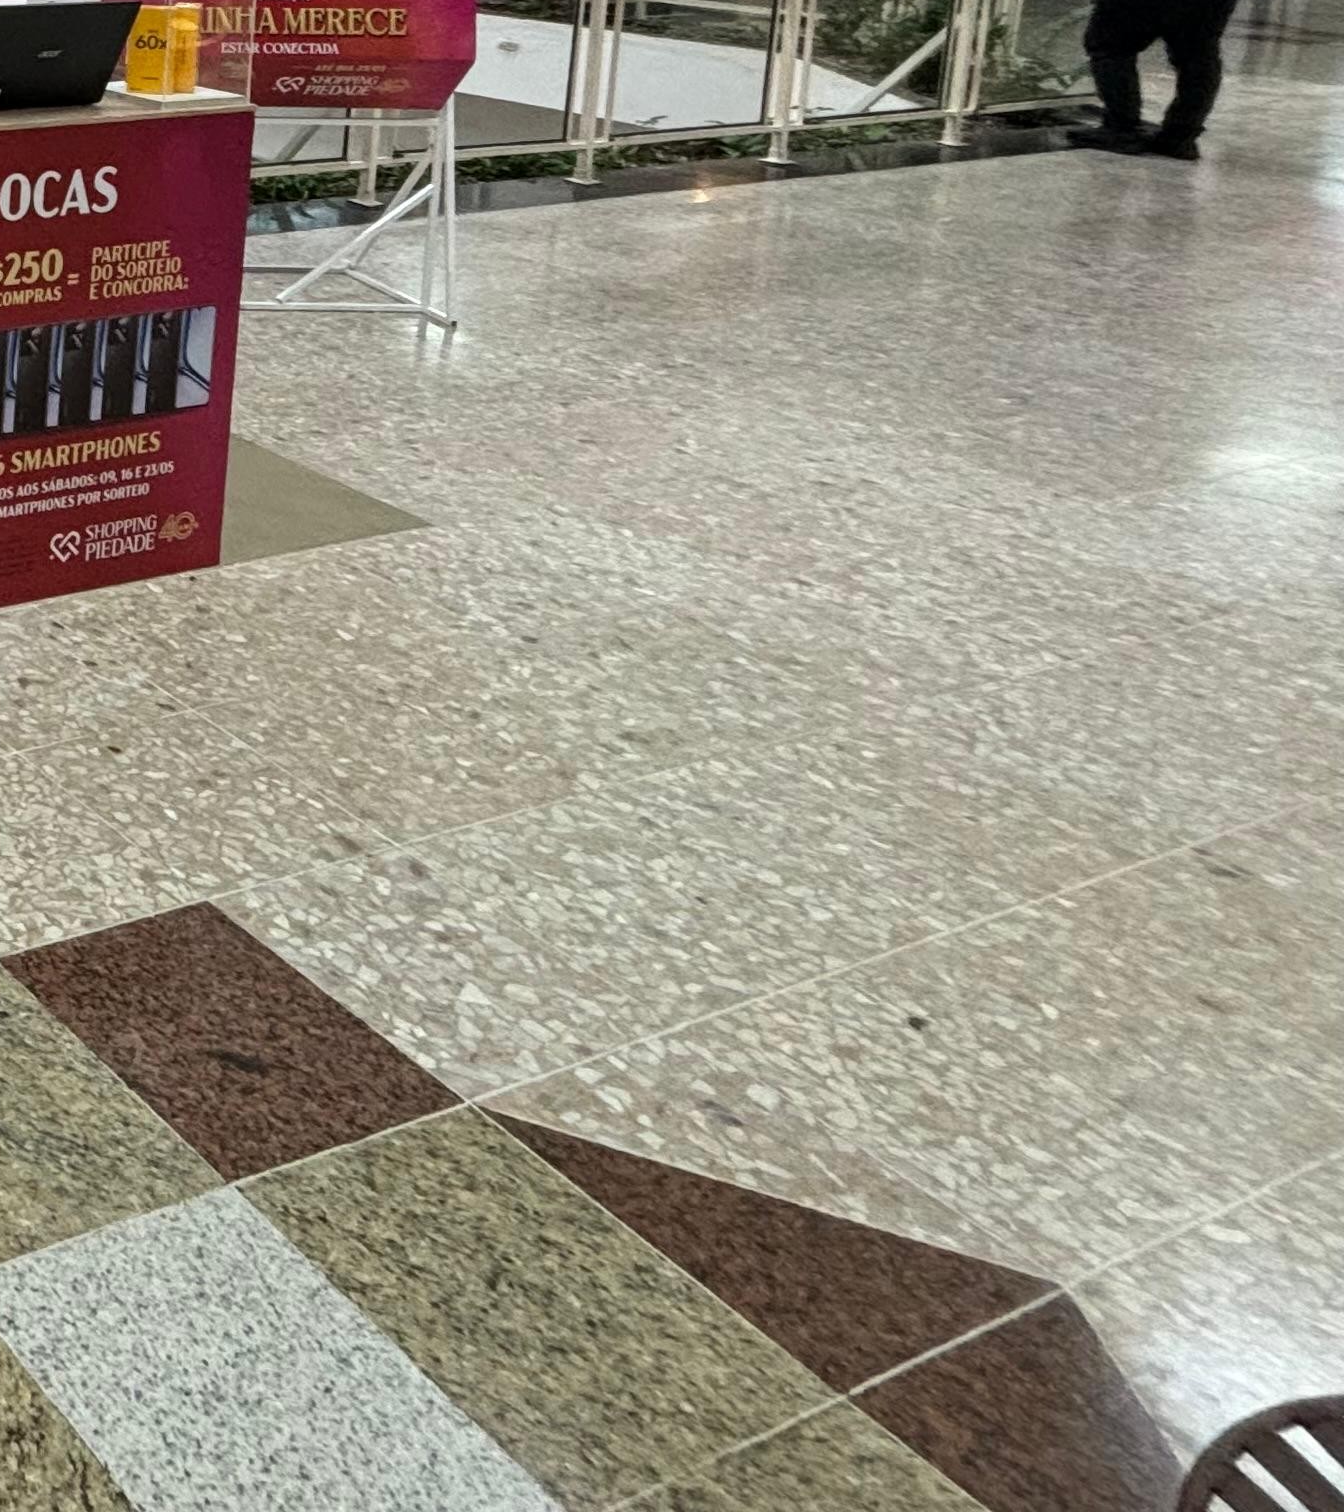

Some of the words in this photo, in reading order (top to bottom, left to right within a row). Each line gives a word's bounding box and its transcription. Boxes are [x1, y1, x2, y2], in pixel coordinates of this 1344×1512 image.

[200, 6, 278, 35] INHA
[282, 7, 408, 36] MERECE
[135, 35, 168, 50] 60x
[220, 41, 260, 55] ESTAR
[262, 42, 340, 55] CONECTADA
[91, 240, 171, 264] PARTICIPE
[90, 264, 113, 283] DO
[113, 256, 182, 279] SORTEIO
[89, 283, 100, 300] E
[102, 274, 190, 299] CONCORRA:
[9, 431, 162, 474] SMARTPHONES
[16, 482, 39, 497] AOS
[120, 467, 133, 482] 16
[135, 466, 142, 478] E
[143, 461, 176, 477] 23/05
[76, 492, 101, 507] POR
[103, 483, 151, 502] SORTEIO
[84, 514, 158, 543] SHOPPING
[84, 532, 156, 562] PIEDADE
